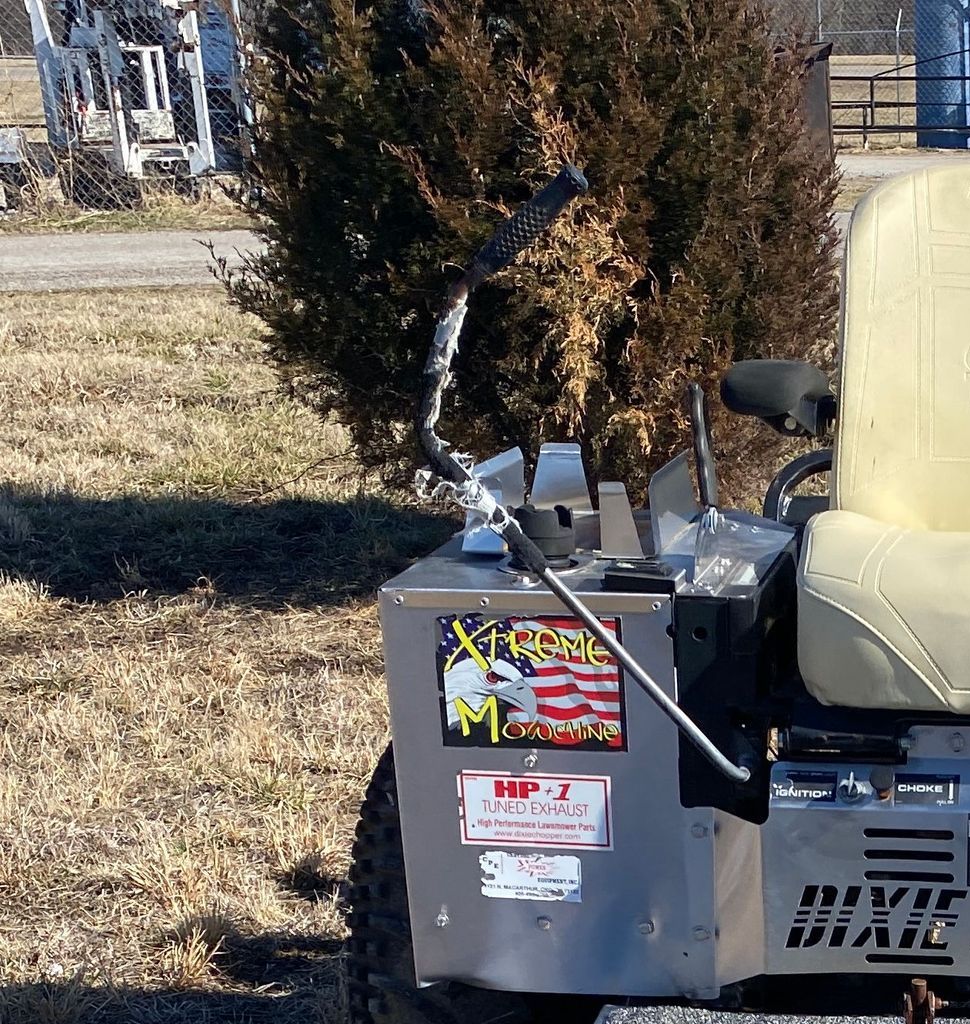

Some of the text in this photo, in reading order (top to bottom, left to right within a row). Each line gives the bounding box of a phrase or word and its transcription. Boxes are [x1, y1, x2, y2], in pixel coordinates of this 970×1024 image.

[494, 779, 540, 799] HP
[898, 784, 943, 793] CHOKE
[482, 800, 589, 817] TUNED EXHAUST
[477, 819, 493, 828] High
[494, 819, 536, 830] Performance
[537, 820, 577, 831] Lawnmower
[785, 885, 967, 950] DIXIE
